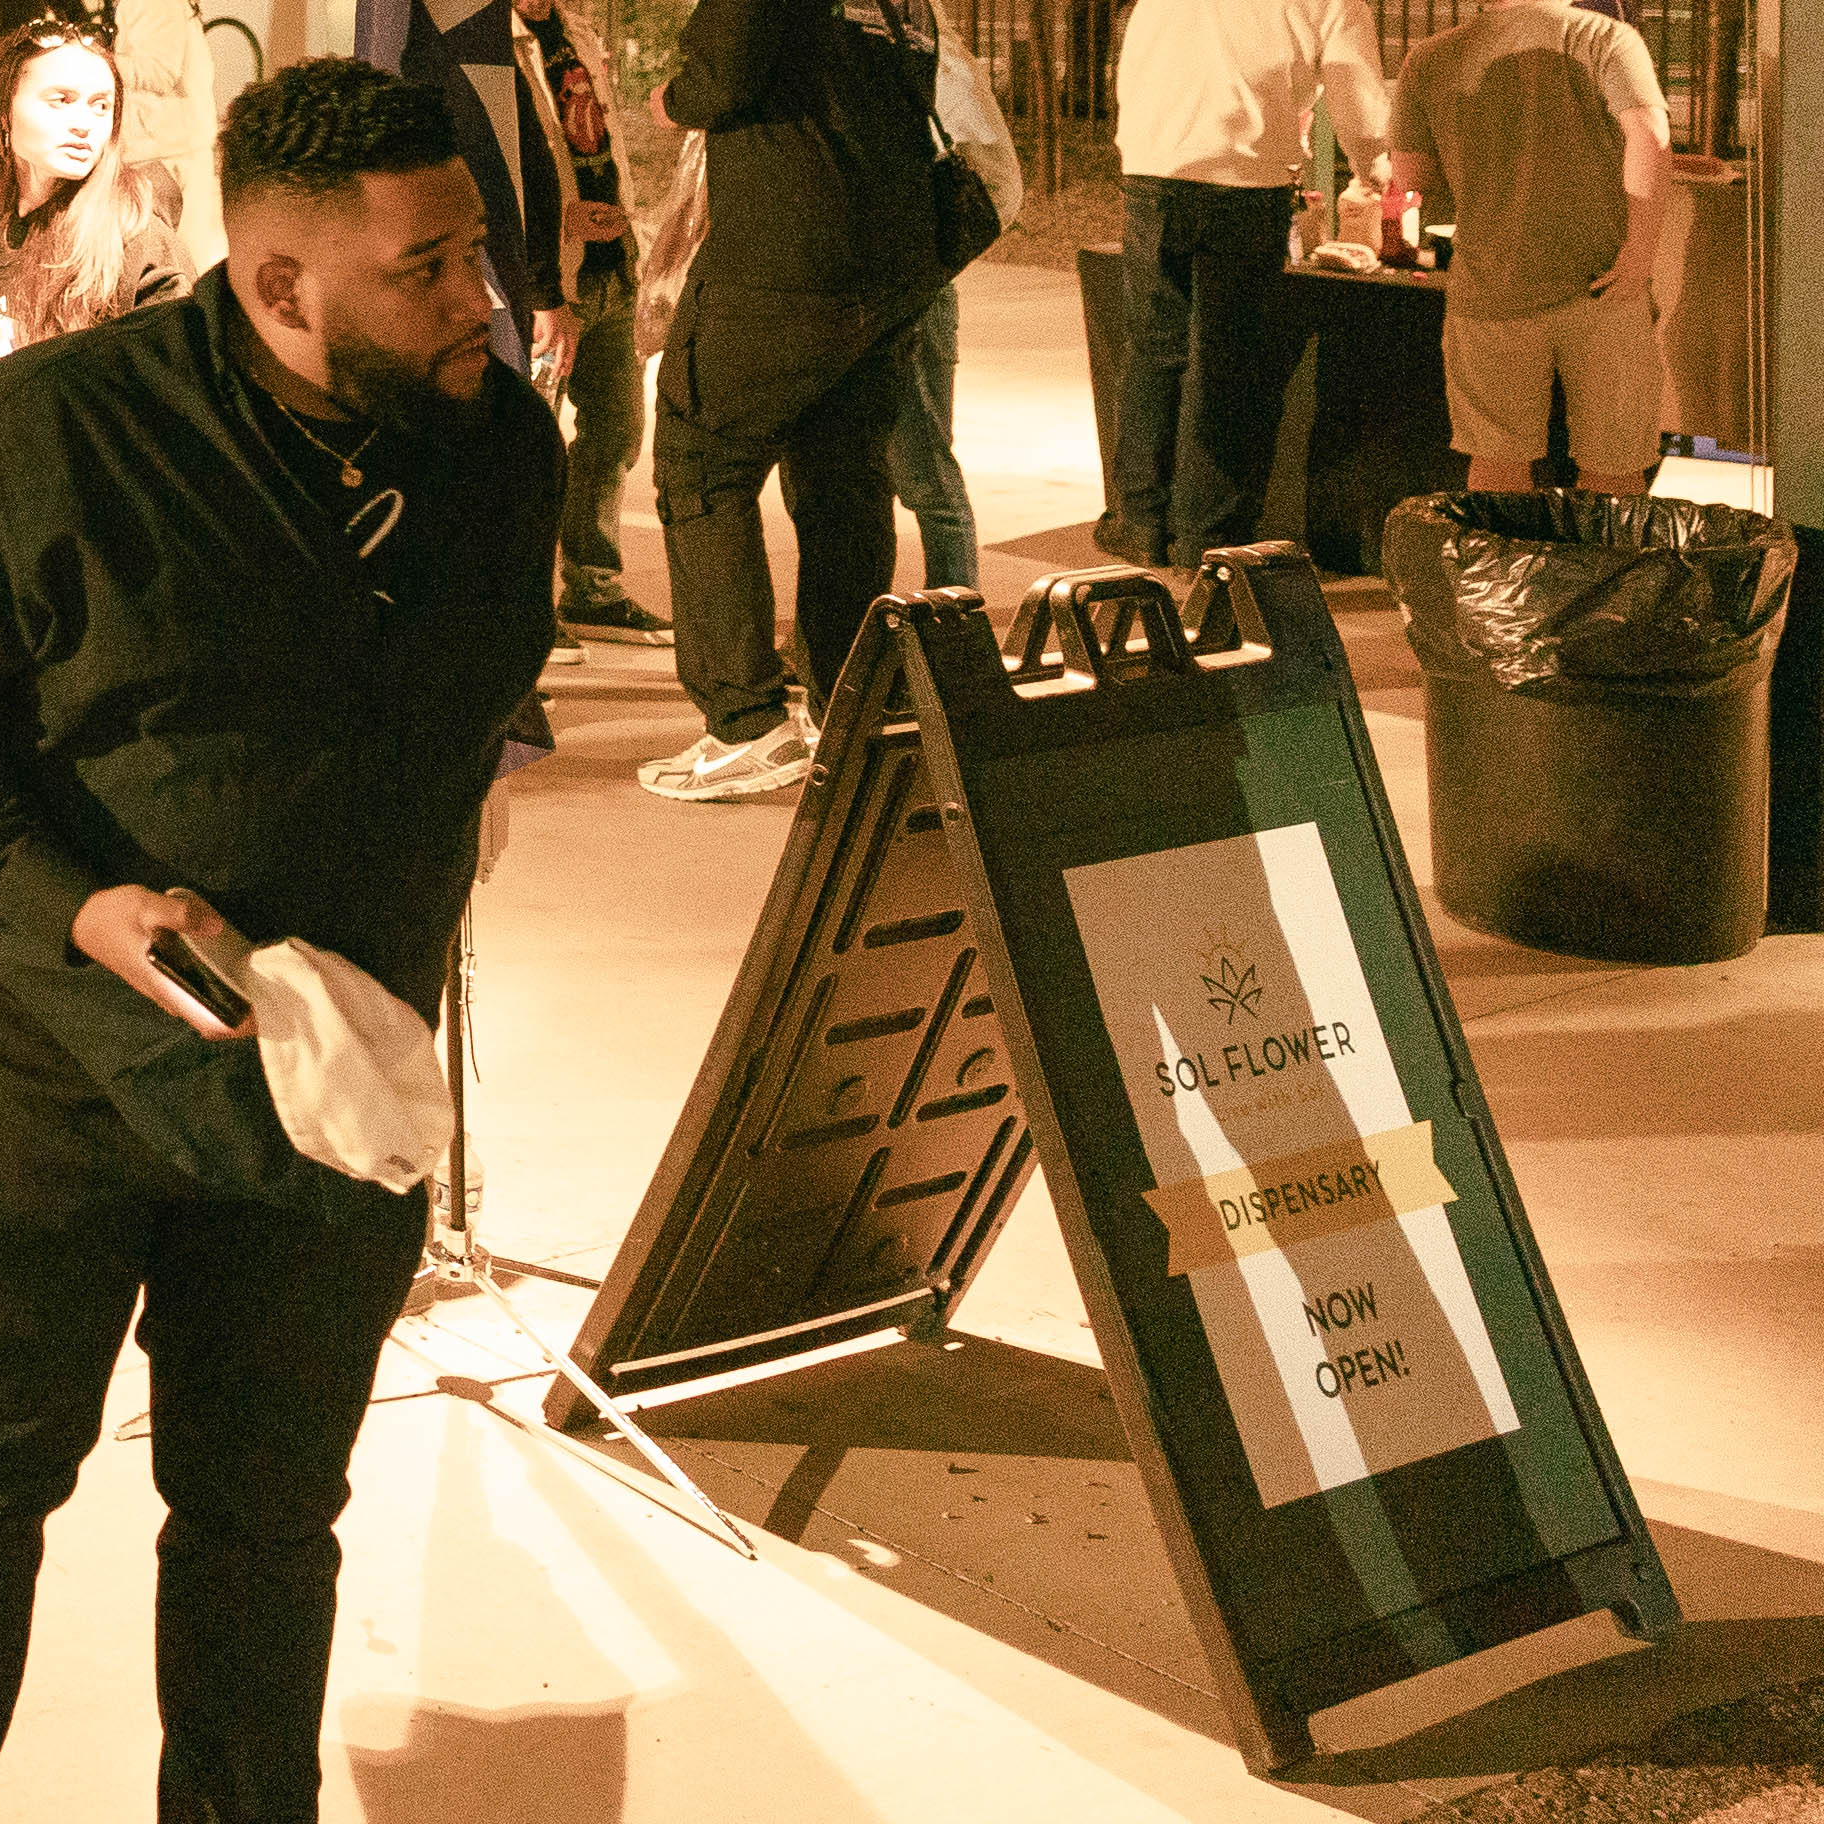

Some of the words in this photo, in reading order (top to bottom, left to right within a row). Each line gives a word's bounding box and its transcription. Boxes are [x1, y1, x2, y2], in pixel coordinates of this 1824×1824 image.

[1155, 1052, 1220, 1097] SOL
[1223, 1021, 1357, 1081] FLOWER
[1218, 1160, 1383, 1231] DISPENSARY
[1301, 1281, 1379, 1338] NOW
[1315, 1339, 1411, 1399] OPEN!
